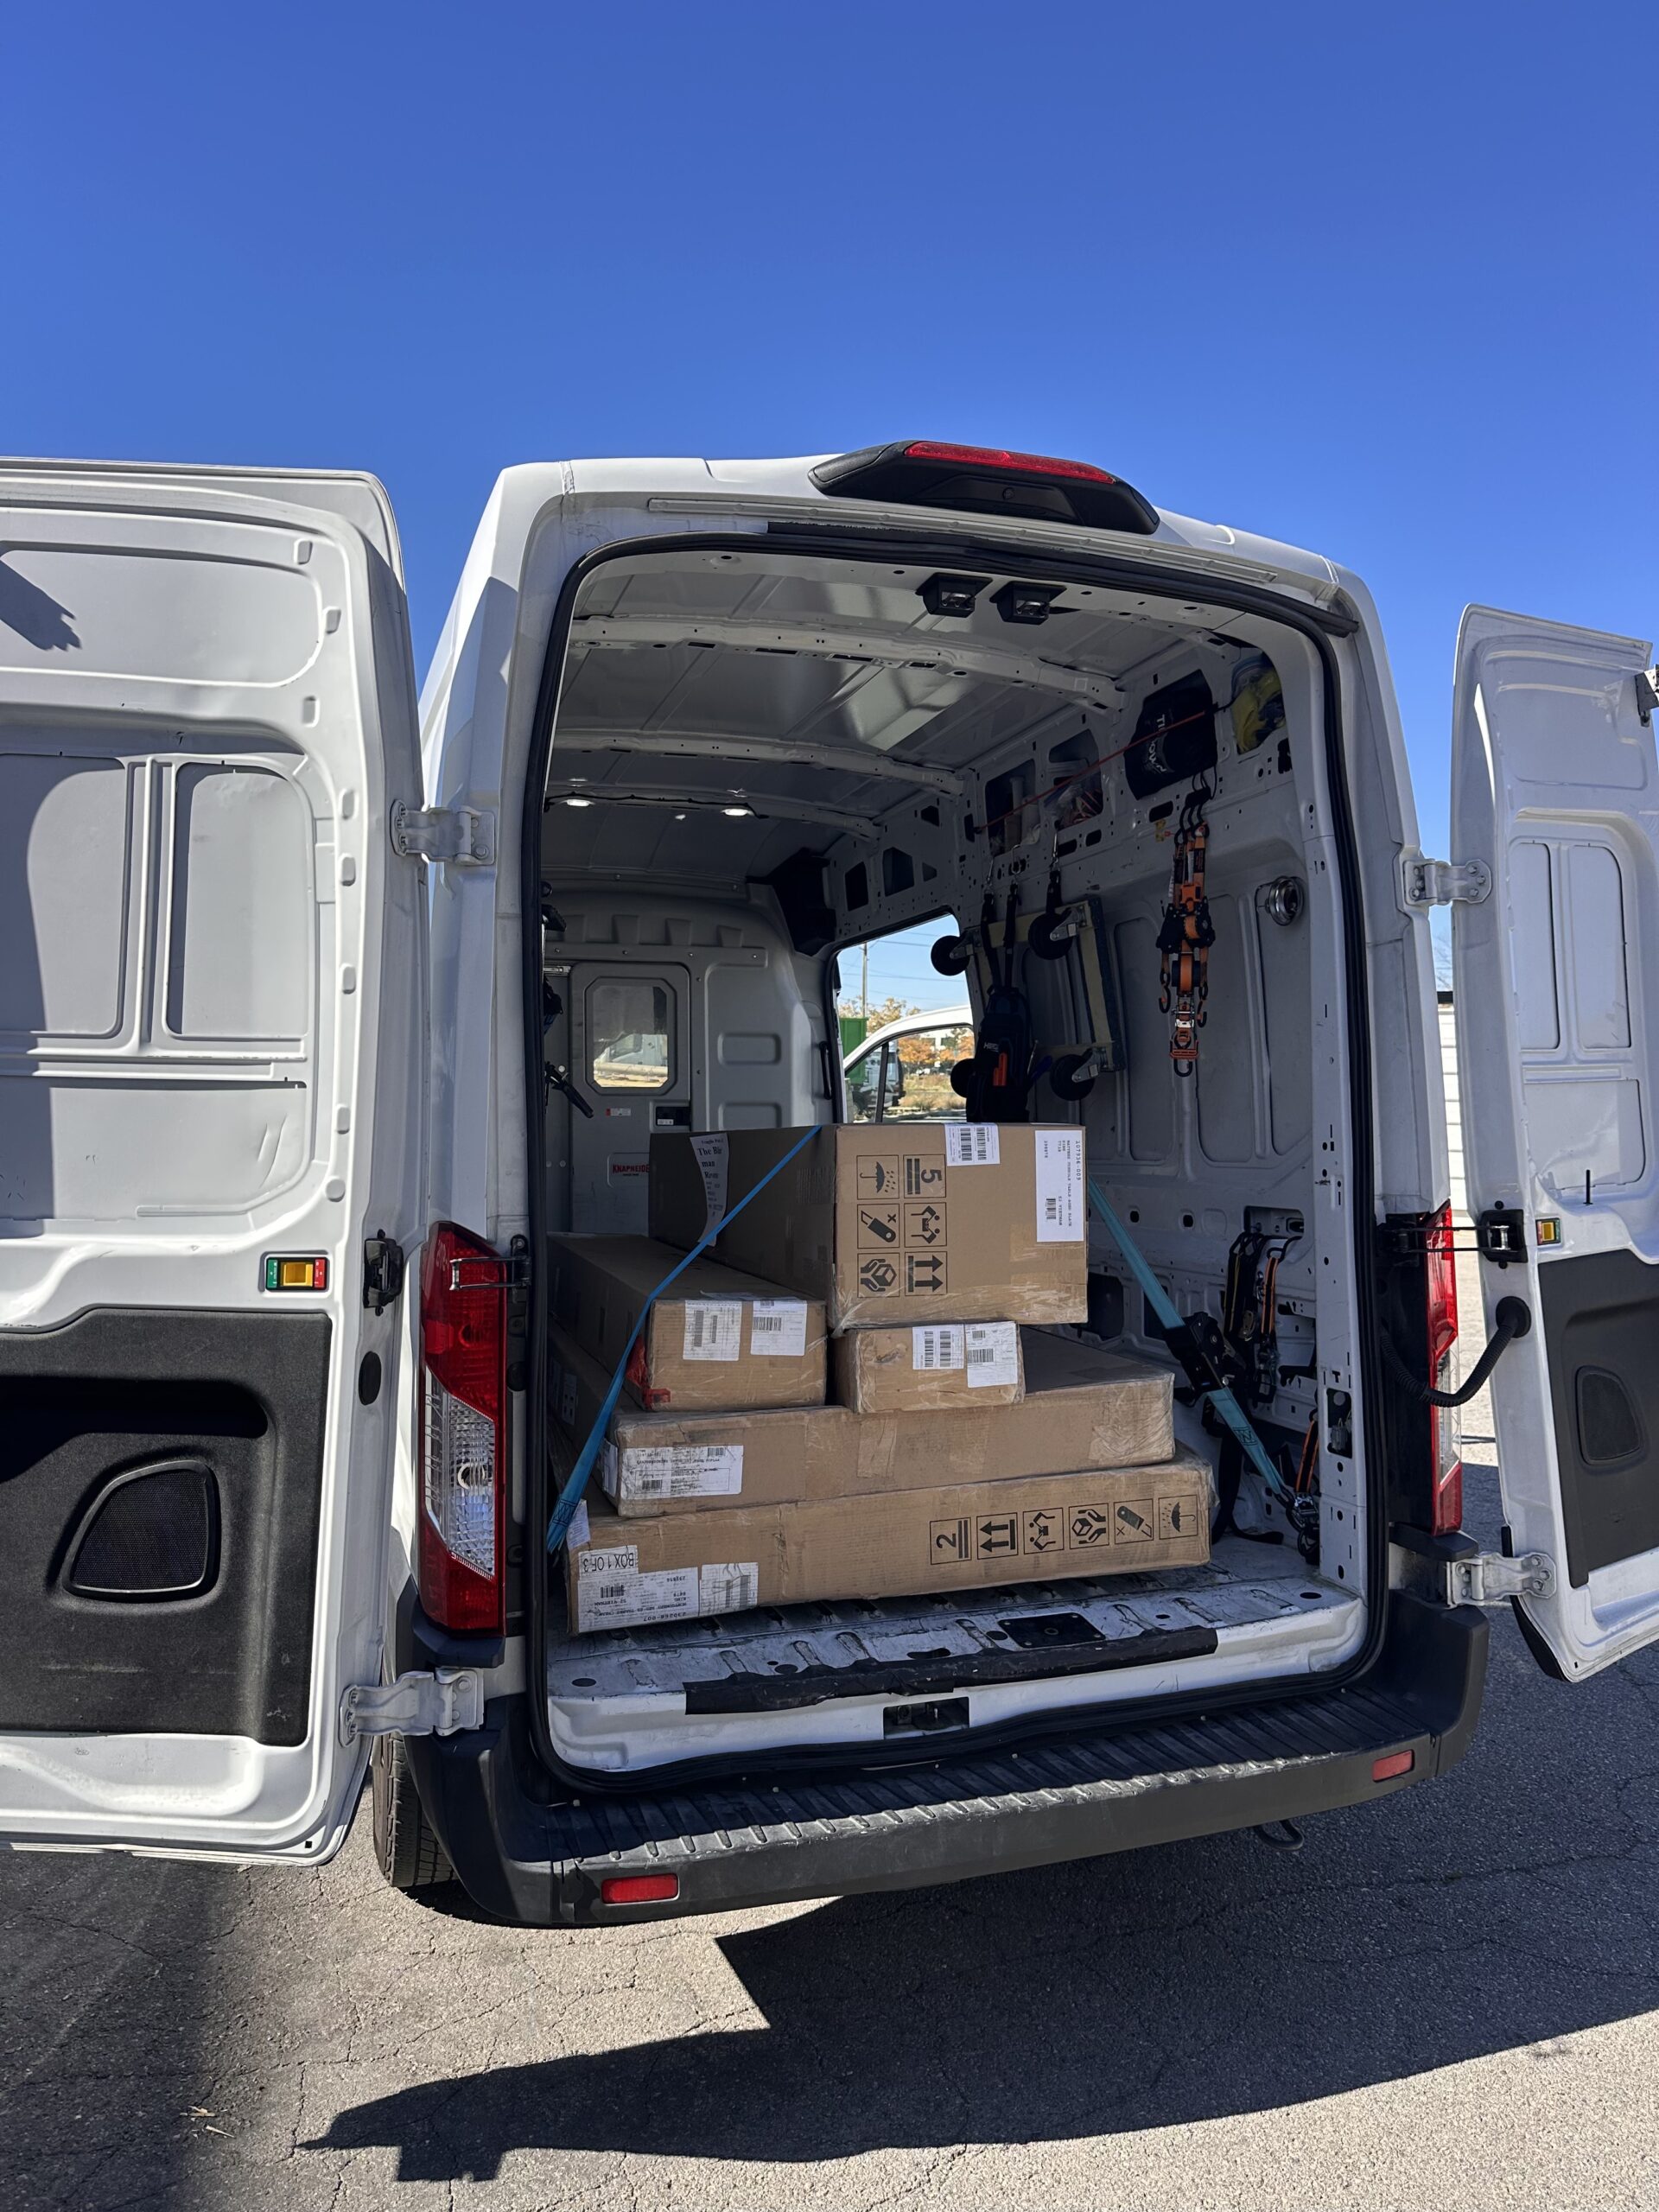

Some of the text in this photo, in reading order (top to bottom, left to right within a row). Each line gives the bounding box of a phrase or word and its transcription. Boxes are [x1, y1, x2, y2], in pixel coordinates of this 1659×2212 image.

[920, 1168, 943, 1184] 5
[935, 1532, 957, 1549] 2
[582, 1552, 634, 1573] BOX 1 OF 3
